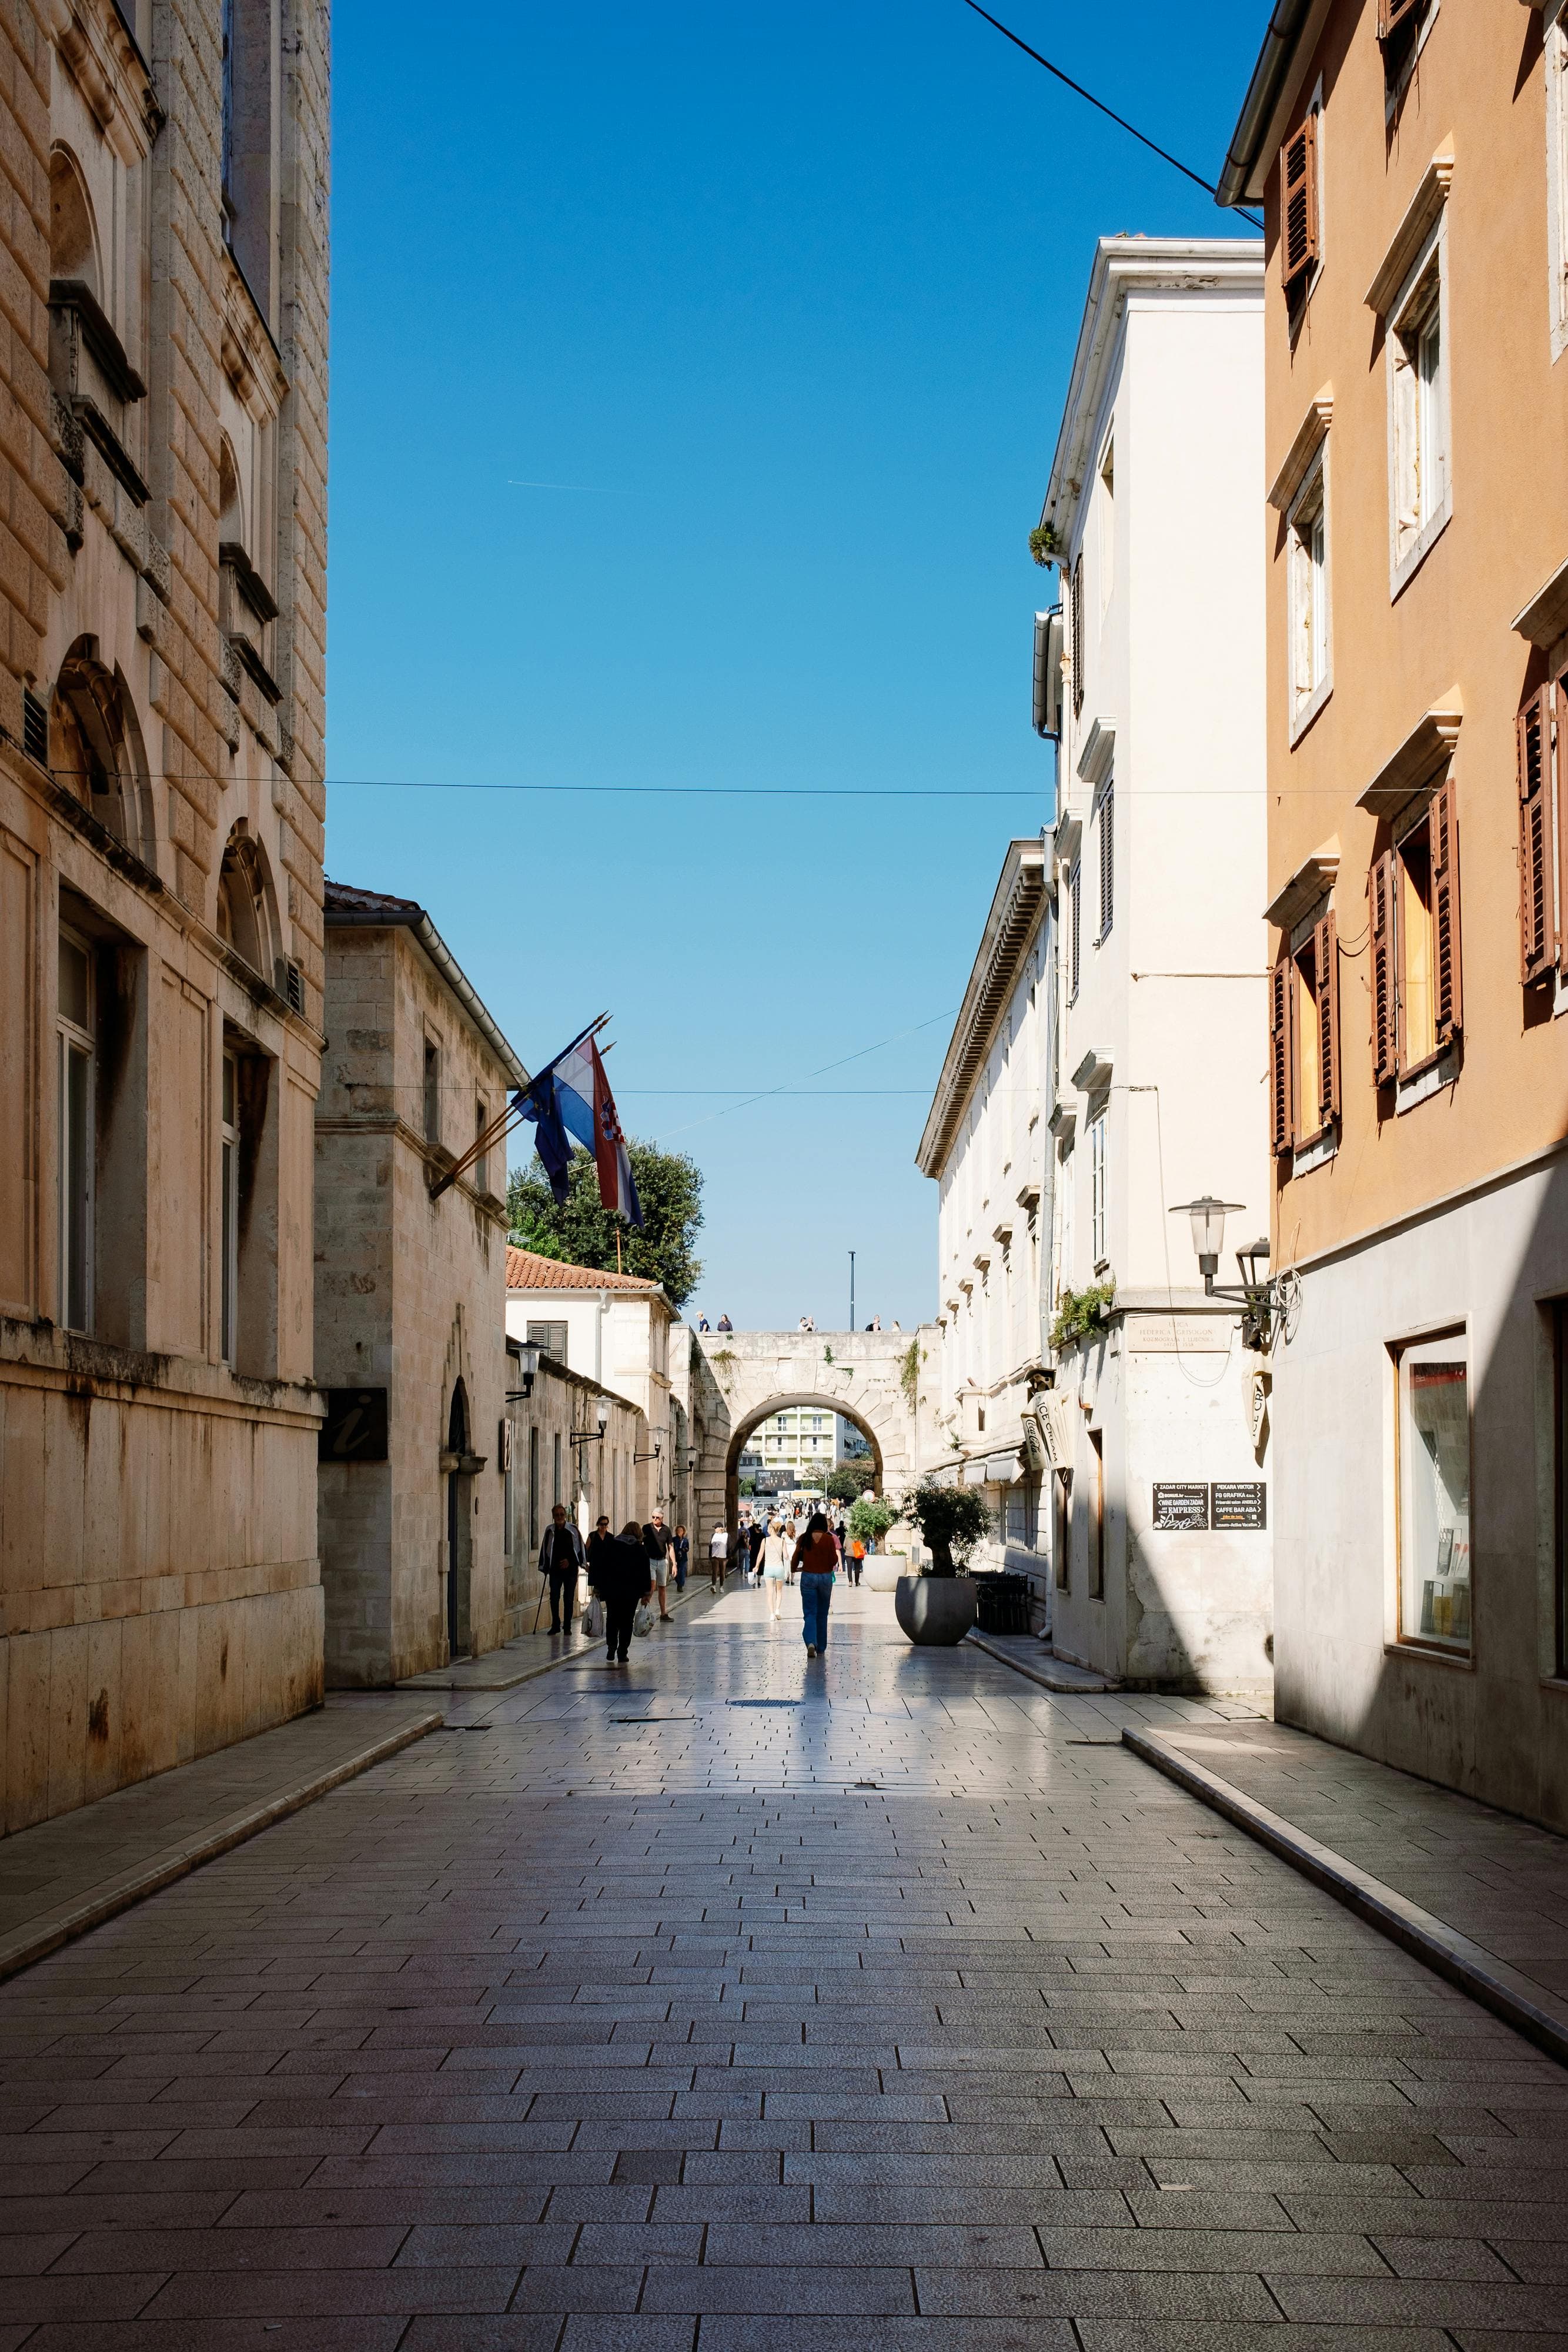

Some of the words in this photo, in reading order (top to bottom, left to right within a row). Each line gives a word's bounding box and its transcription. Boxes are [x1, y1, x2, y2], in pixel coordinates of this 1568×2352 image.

[1025, 1419, 1042, 1455] Coca-Cola
[1037, 1402, 1049, 1421] ICE
[1046, 1422, 1058, 1462] CREAM
